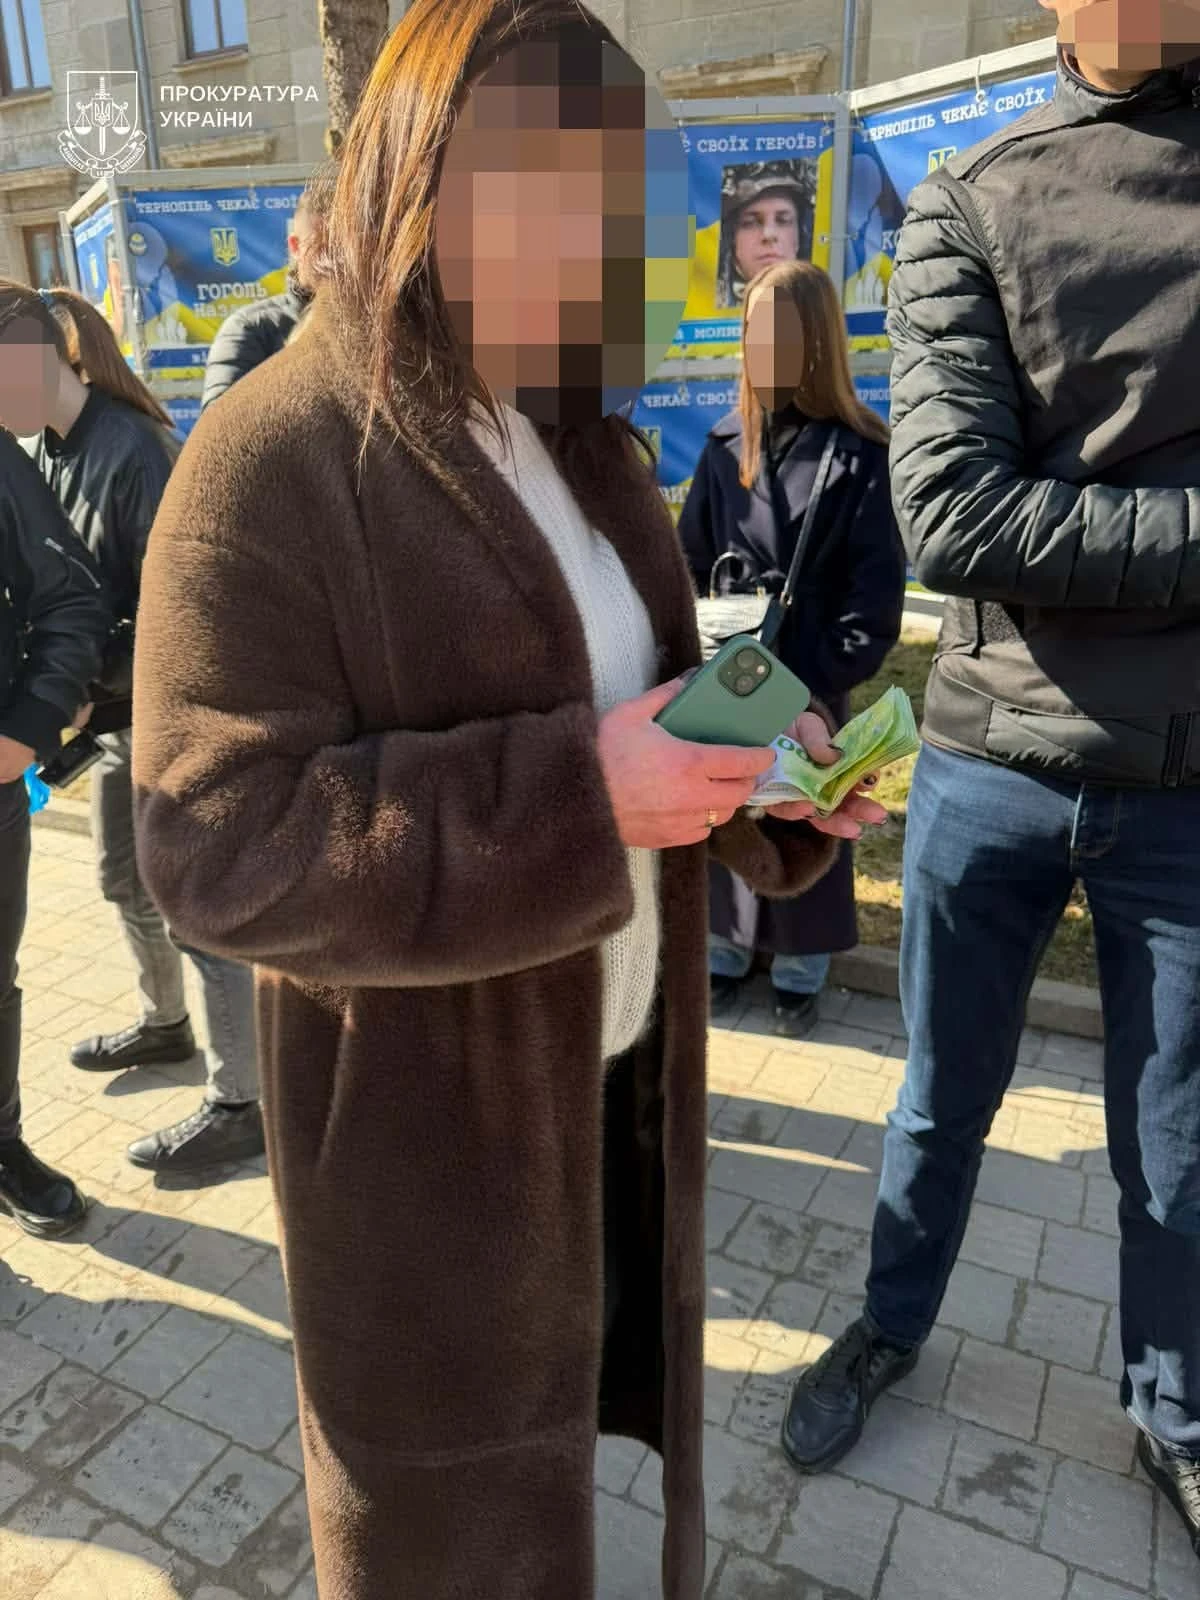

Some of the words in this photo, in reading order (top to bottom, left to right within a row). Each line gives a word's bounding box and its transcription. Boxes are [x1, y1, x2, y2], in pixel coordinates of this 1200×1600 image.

[862, 114, 936, 143] ТЕРНОПІЛЬ
[941, 101, 988, 125] ЧЕКАЄ
[994, 87, 1046, 113] СВОЇХ
[697, 135, 749, 153] СВОЇХ
[755, 132, 824, 151] ГЕРОЇВ!
[264, 194, 298, 209] СВОЇ
[197, 282, 268, 301] ГОГОЛЬ
[696, 389, 739, 406] СВОЇ
